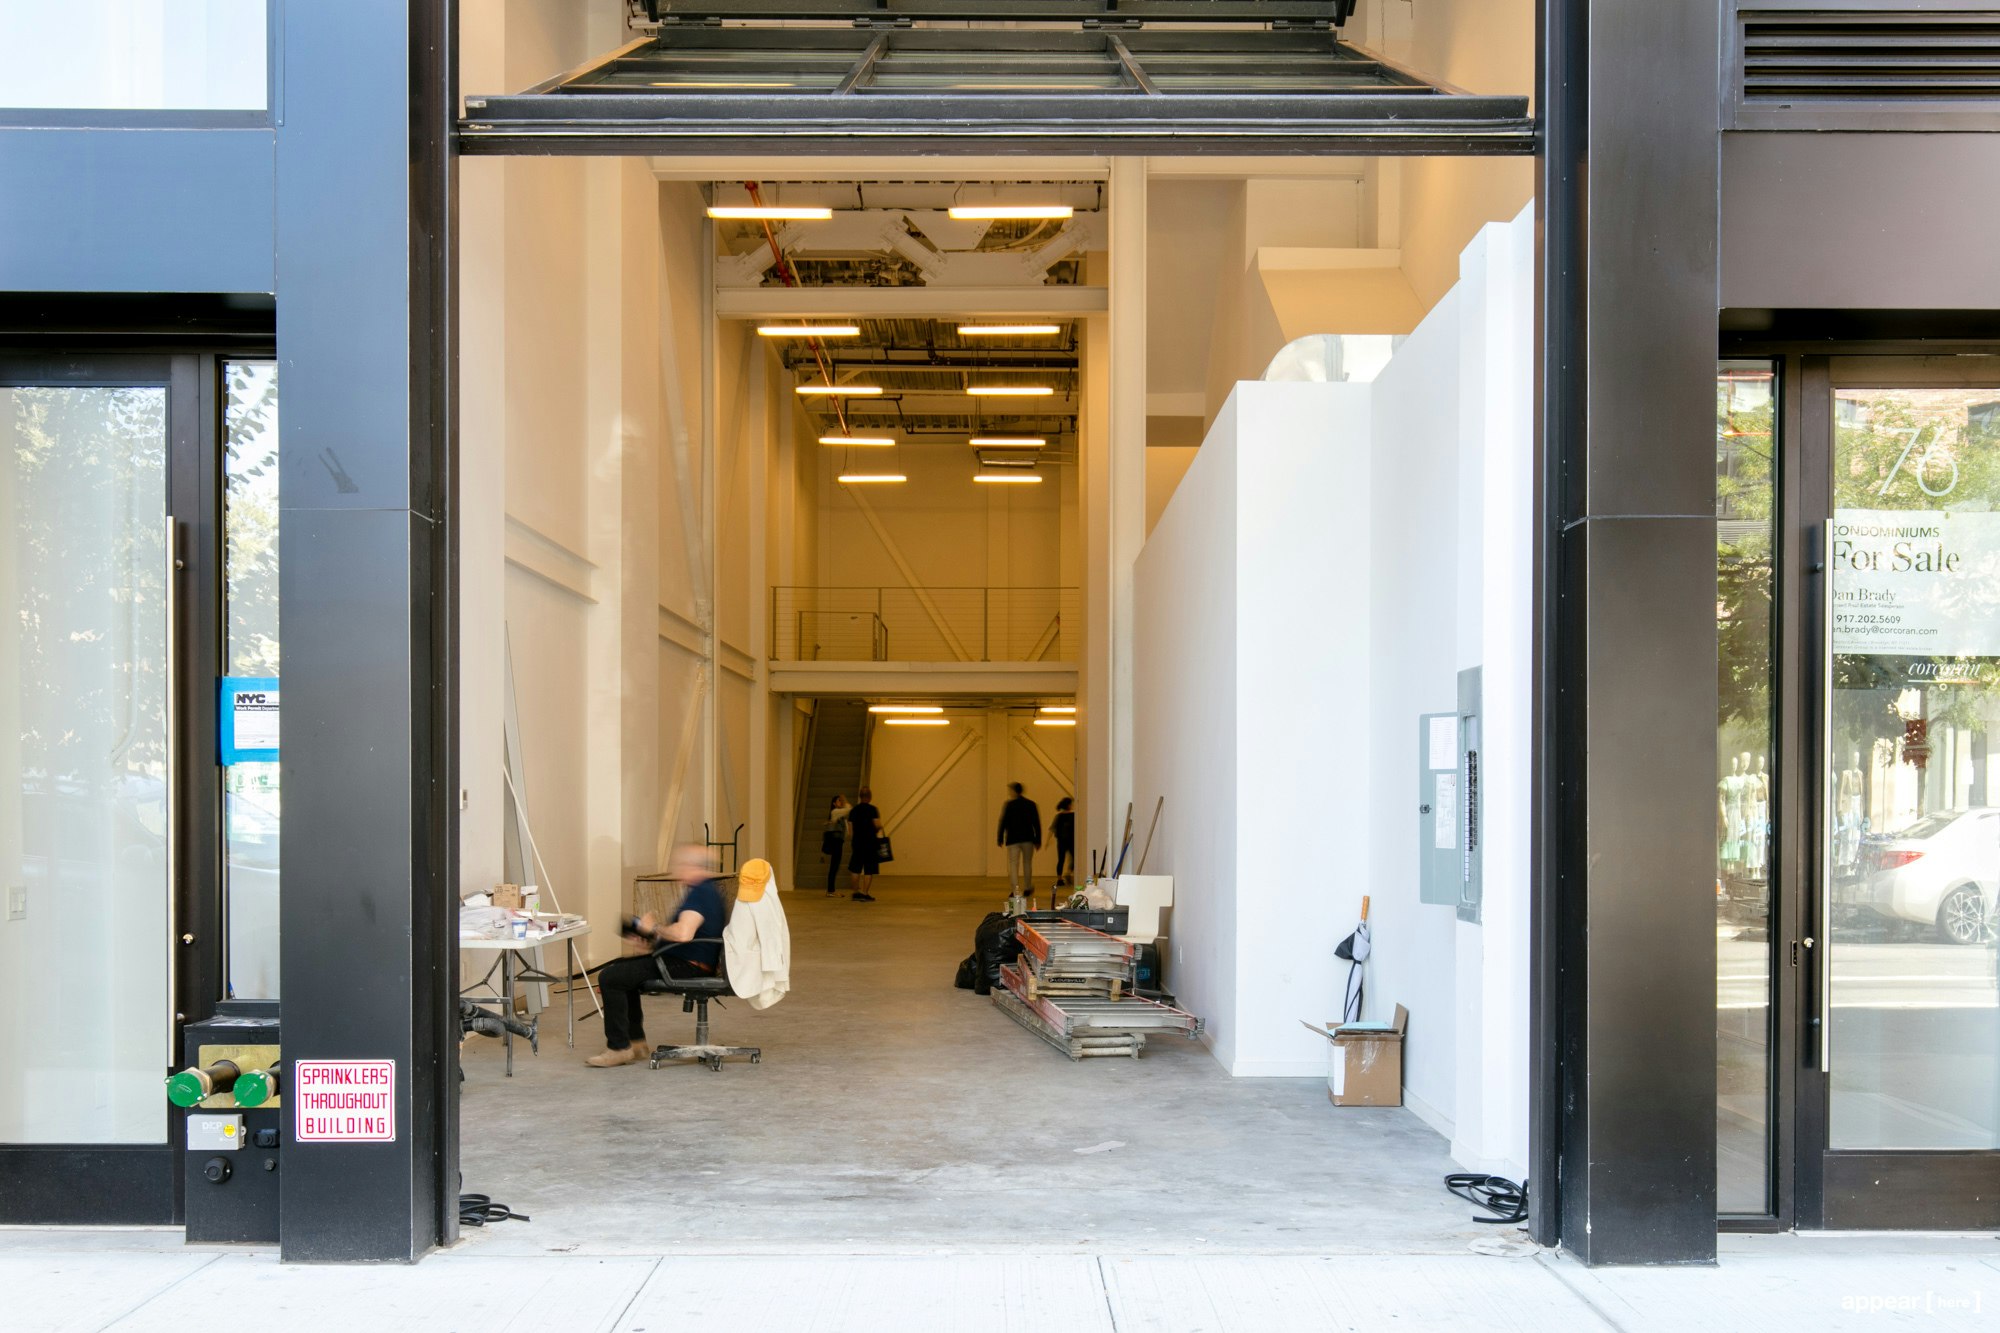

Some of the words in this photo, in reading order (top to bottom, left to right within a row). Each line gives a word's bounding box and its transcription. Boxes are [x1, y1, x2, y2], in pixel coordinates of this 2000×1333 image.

[1879, 426, 1959, 497] 76
[1833, 541, 1882, 571] For
[1892, 541, 1960, 573] Sale
[1859, 588, 1896, 605] Brady
[1836, 614, 1901, 624] 917.202.5609
[236, 693, 266, 704] NYC
[302, 1068, 388, 1085] SPRINKLERS
[302, 1093, 388, 1110] THROUGHOUT
[306, 1117, 385, 1134] BUILDING
